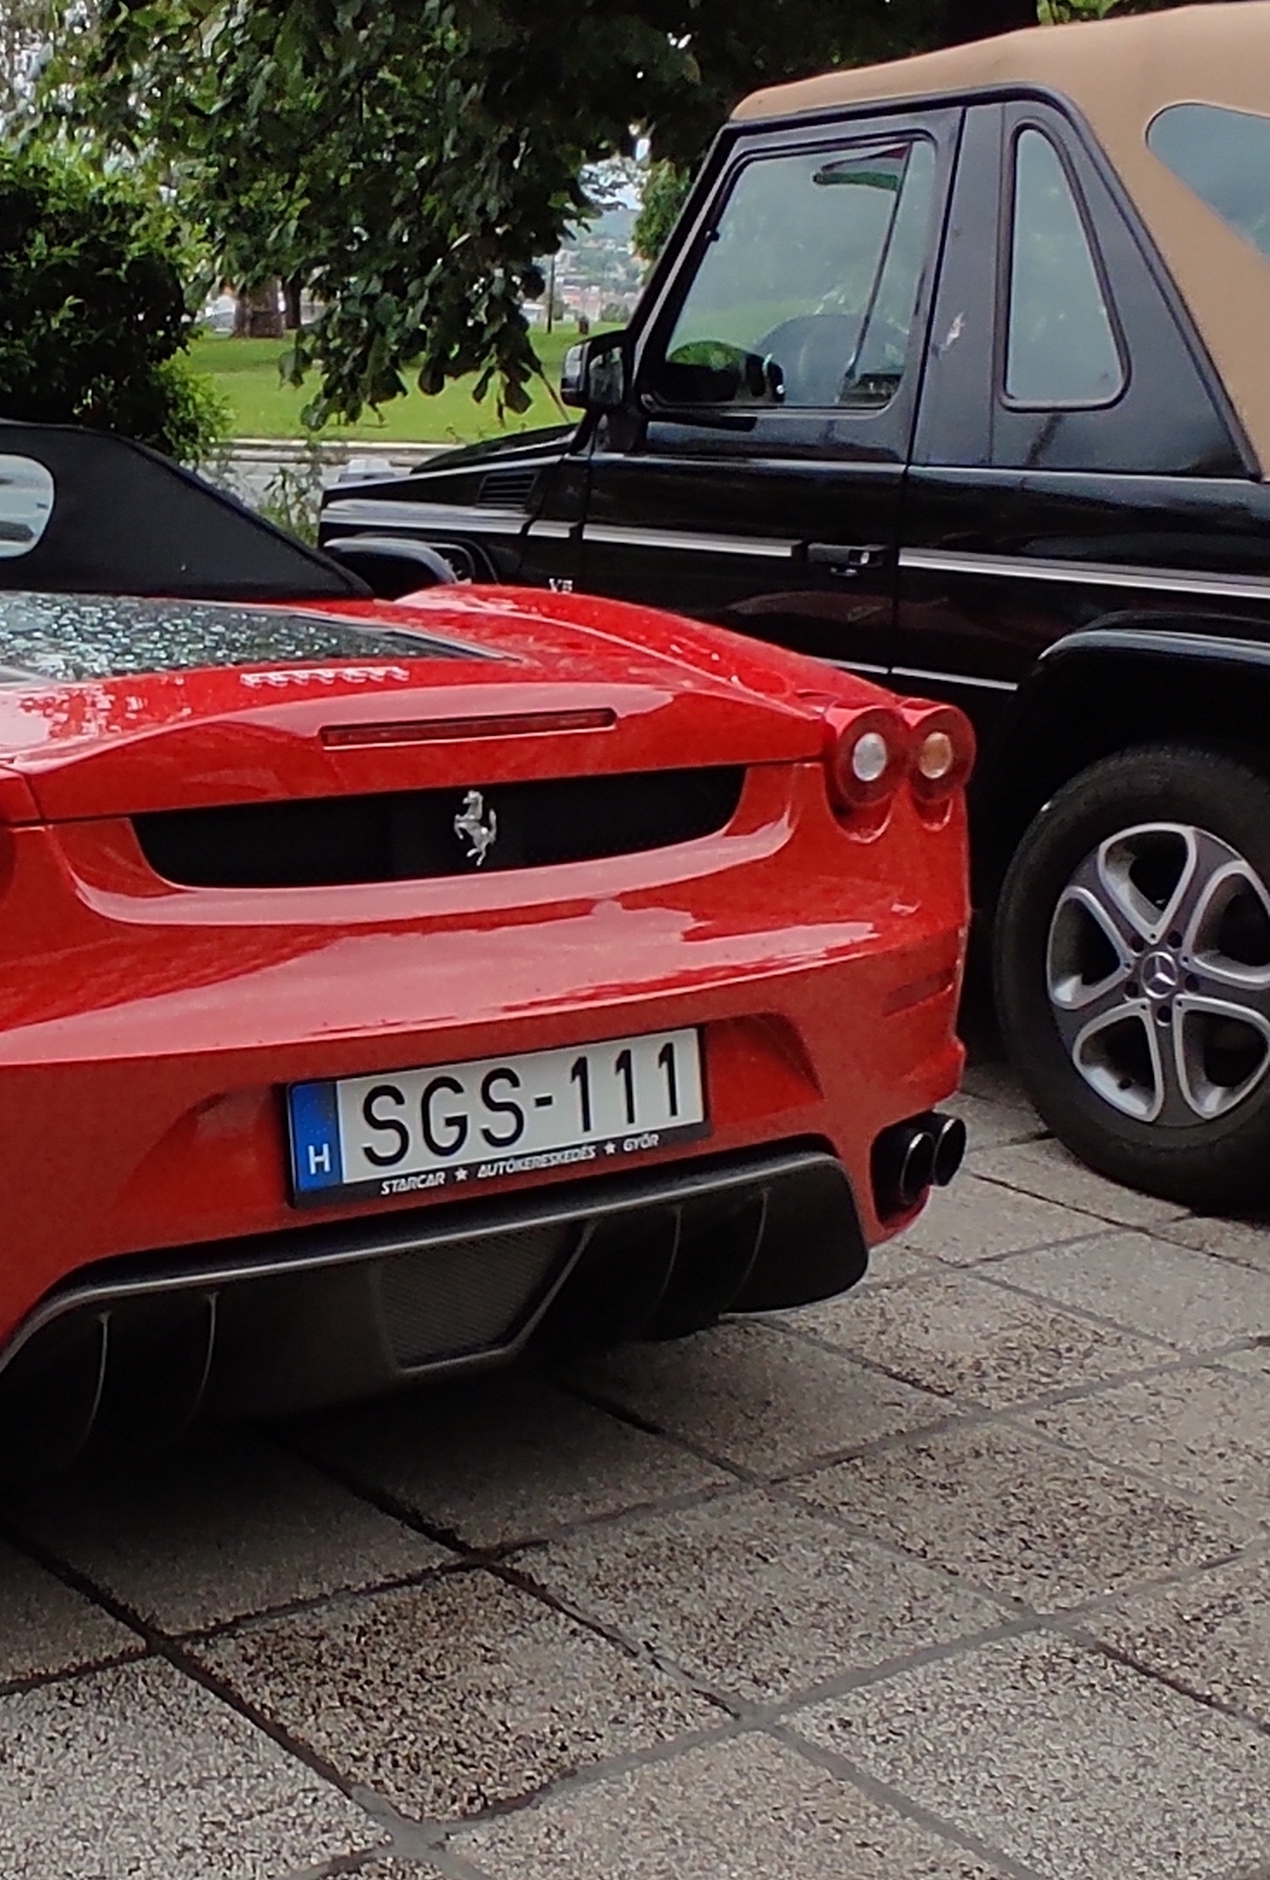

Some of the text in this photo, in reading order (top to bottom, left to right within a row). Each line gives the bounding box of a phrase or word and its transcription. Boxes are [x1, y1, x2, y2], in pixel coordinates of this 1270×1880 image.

[361, 1041, 679, 1167] SGS-111
[308, 1143, 330, 1175] H
[380, 1171, 446, 1195] STARCAR
